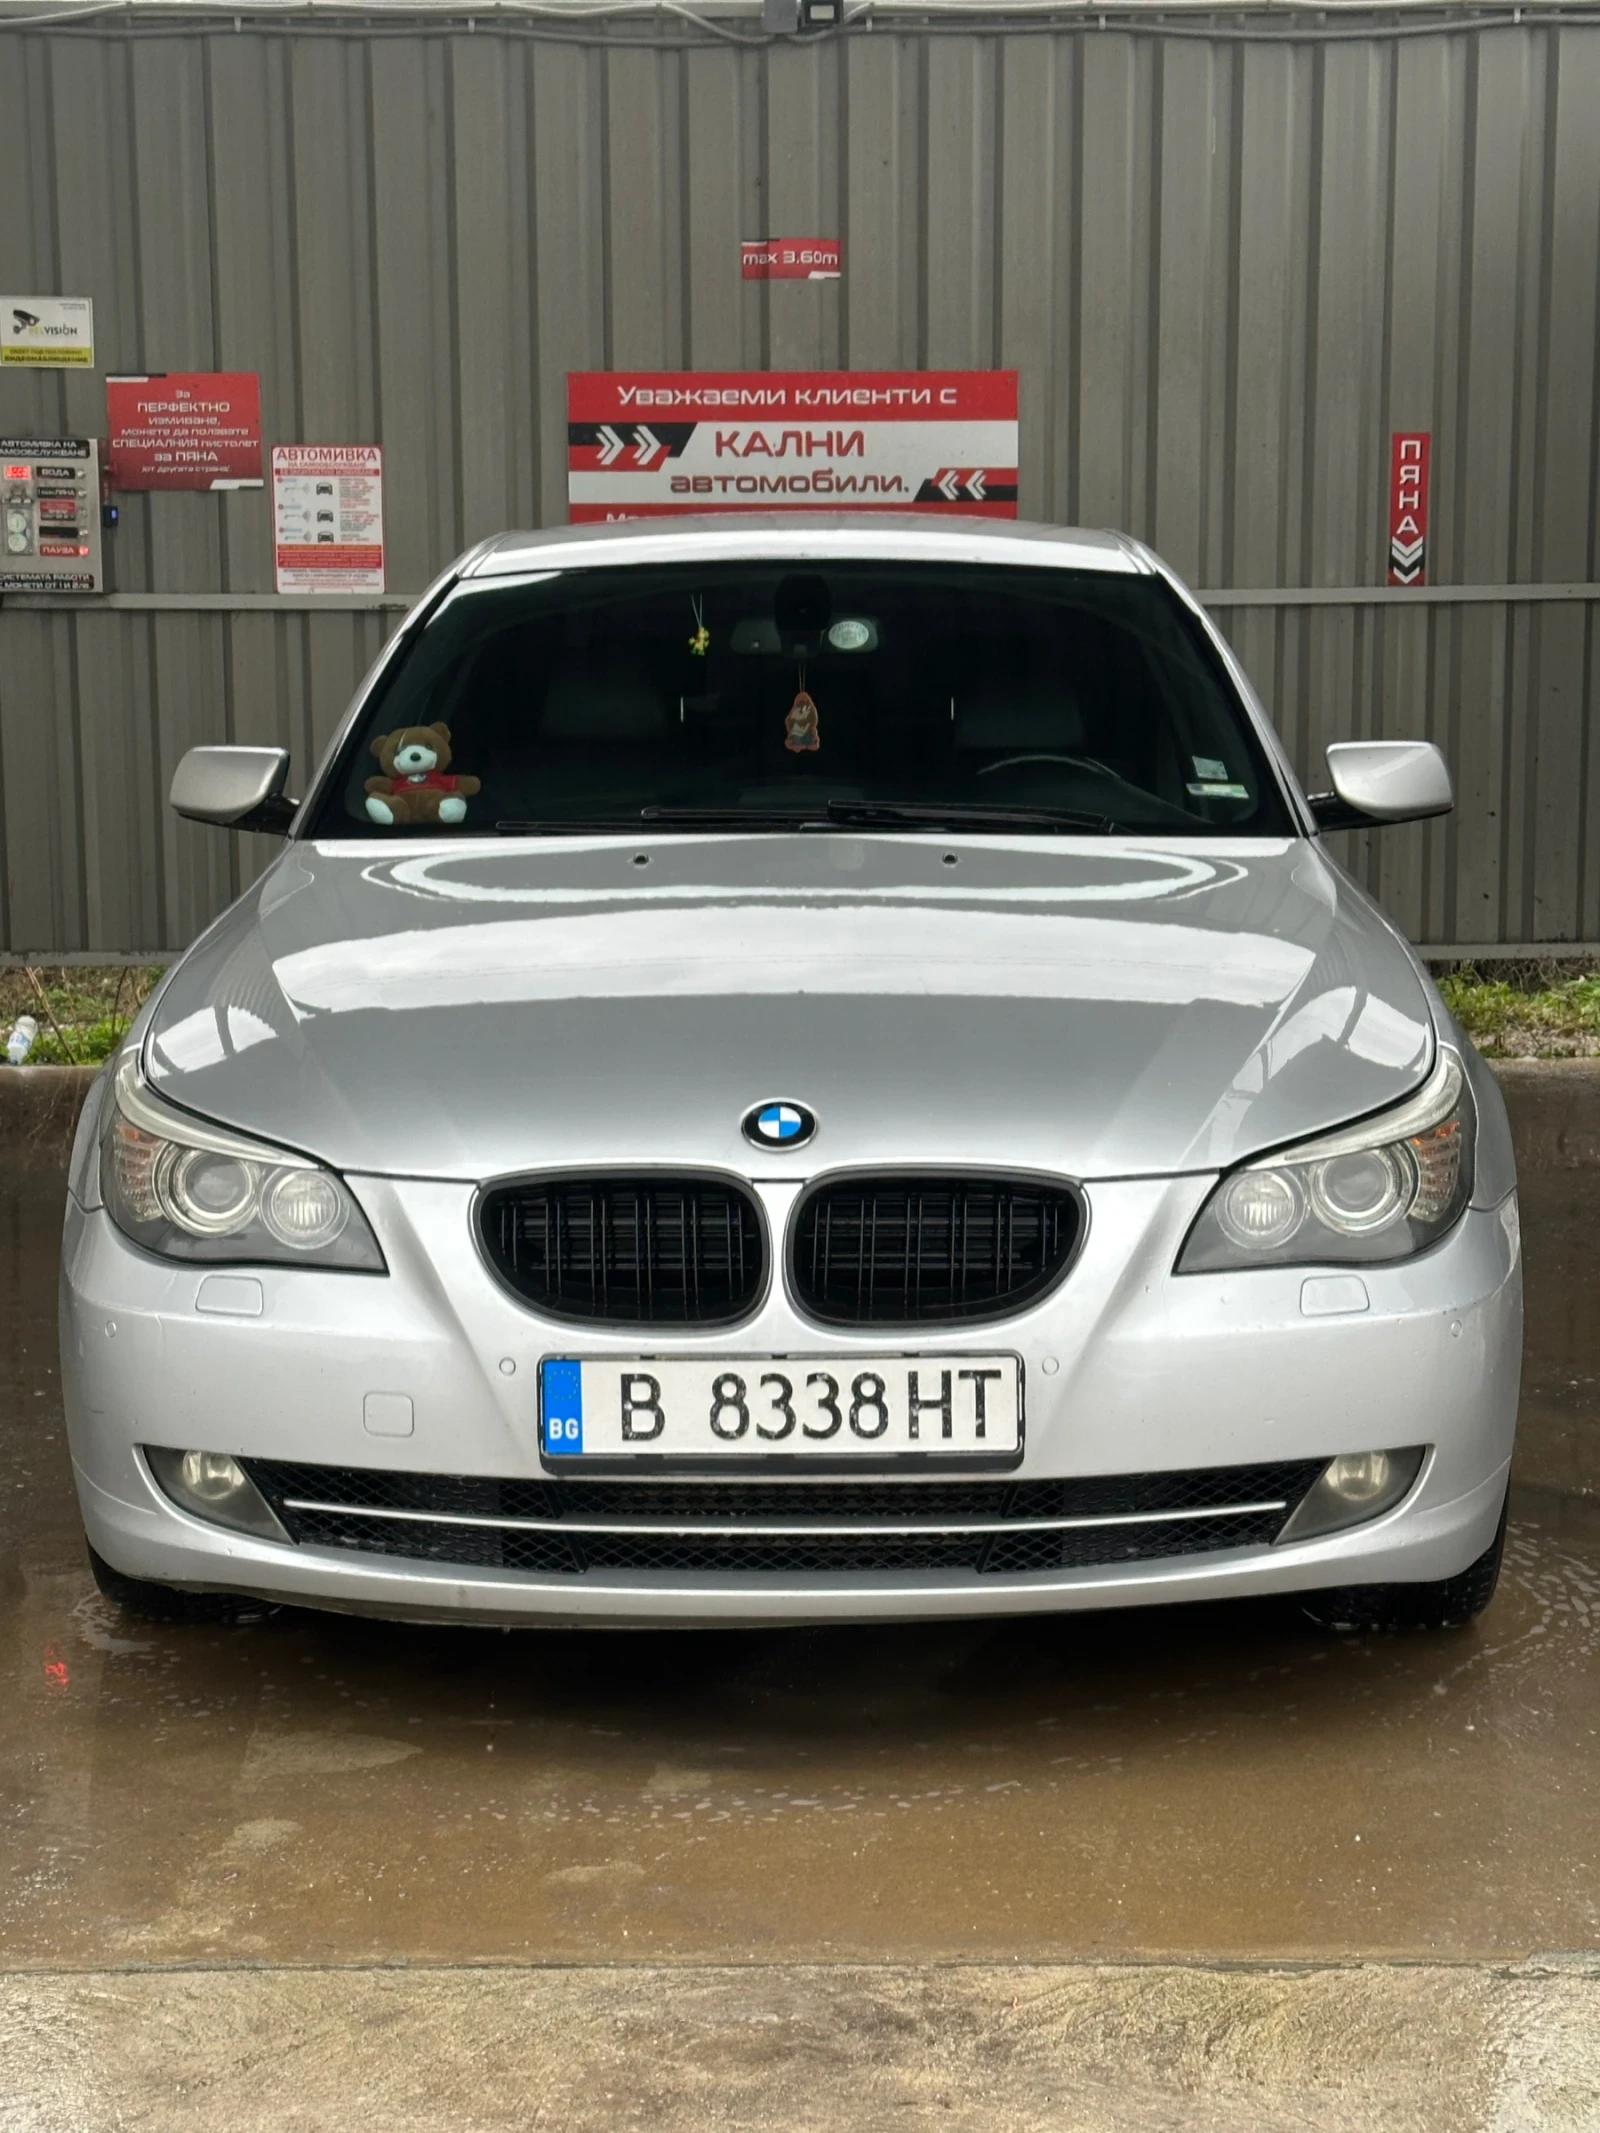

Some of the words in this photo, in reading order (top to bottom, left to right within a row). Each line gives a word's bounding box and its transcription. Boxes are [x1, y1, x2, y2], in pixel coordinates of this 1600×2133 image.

[743, 253, 778, 265] max
[176, 390, 191, 399] За
[617, 386, 786, 405] Уважаеми
[795, 388, 931, 405] клиенти
[940, 388, 957, 404] с
[137, 402, 230, 413] ПЕРФЕКТНО
[148, 417, 221, 426] измиване,
[121, 428, 171, 436] можете
[173, 428, 189, 437] да
[191, 428, 249, 436] ползвате
[1, 440, 61, 448] АВТОМИВКА
[63, 440, 77, 448] НА
[112, 439, 198, 450] СПЕЦИАЛНИЯ
[201, 440, 259, 448] пистолет
[715, 430, 865, 457] КАЛНИ
[0, 448, 86, 457] АМООБСЛУЖВАНЕ
[154, 453, 172, 462] за
[175, 451, 218, 462] ПЯНА
[276, 448, 377, 461] АВТОМИВКА
[41, 468, 70, 476] ВОДА
[670, 467, 909, 493] автомобили.
[1396, 440, 1421, 534] ПЯНА
[42, 546, 75, 554] ПАУЗА
[620, 1373, 665, 1442] B
[709, 1372, 889, 1441] 8338
[907, 1369, 1002, 1440] HT
[549, 1418, 579, 1440] BG
